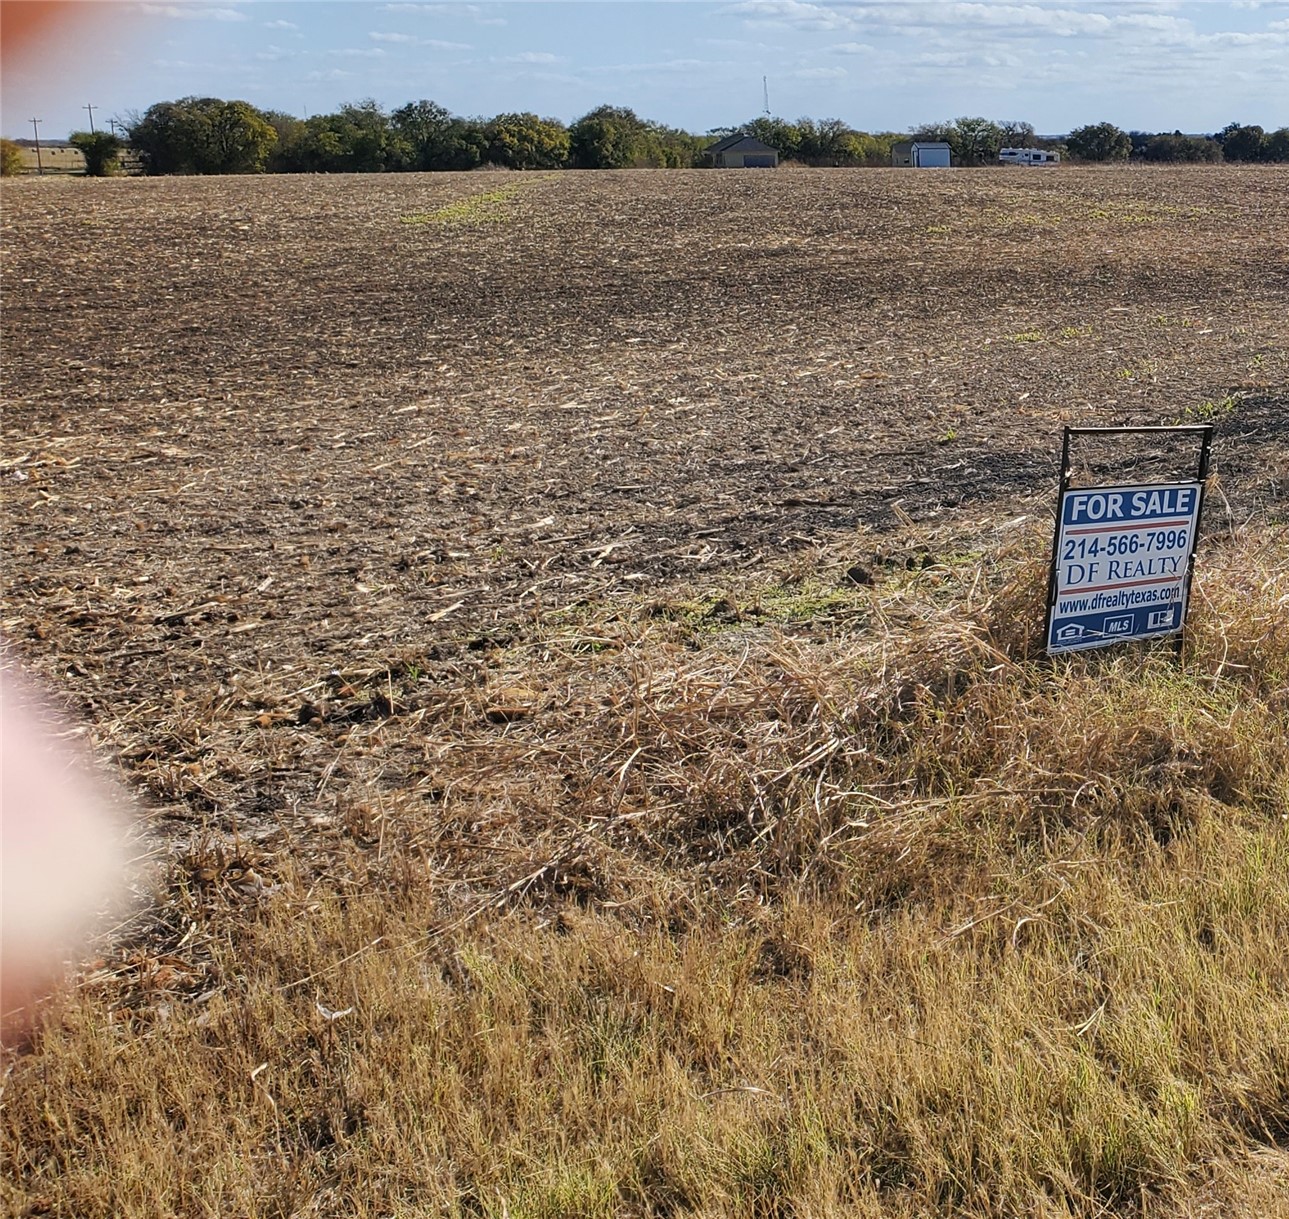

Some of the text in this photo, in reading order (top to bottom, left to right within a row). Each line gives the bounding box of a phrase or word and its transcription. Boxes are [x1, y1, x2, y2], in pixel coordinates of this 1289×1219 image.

[1071, 490, 1190, 521] FOR SALE
[1064, 530, 1187, 560] 214-566-7996
[1065, 562, 1099, 585] DF
[1059, 585, 1180, 613] www.dfrealtytexas.com
[1108, 619, 1130, 632] MLS
